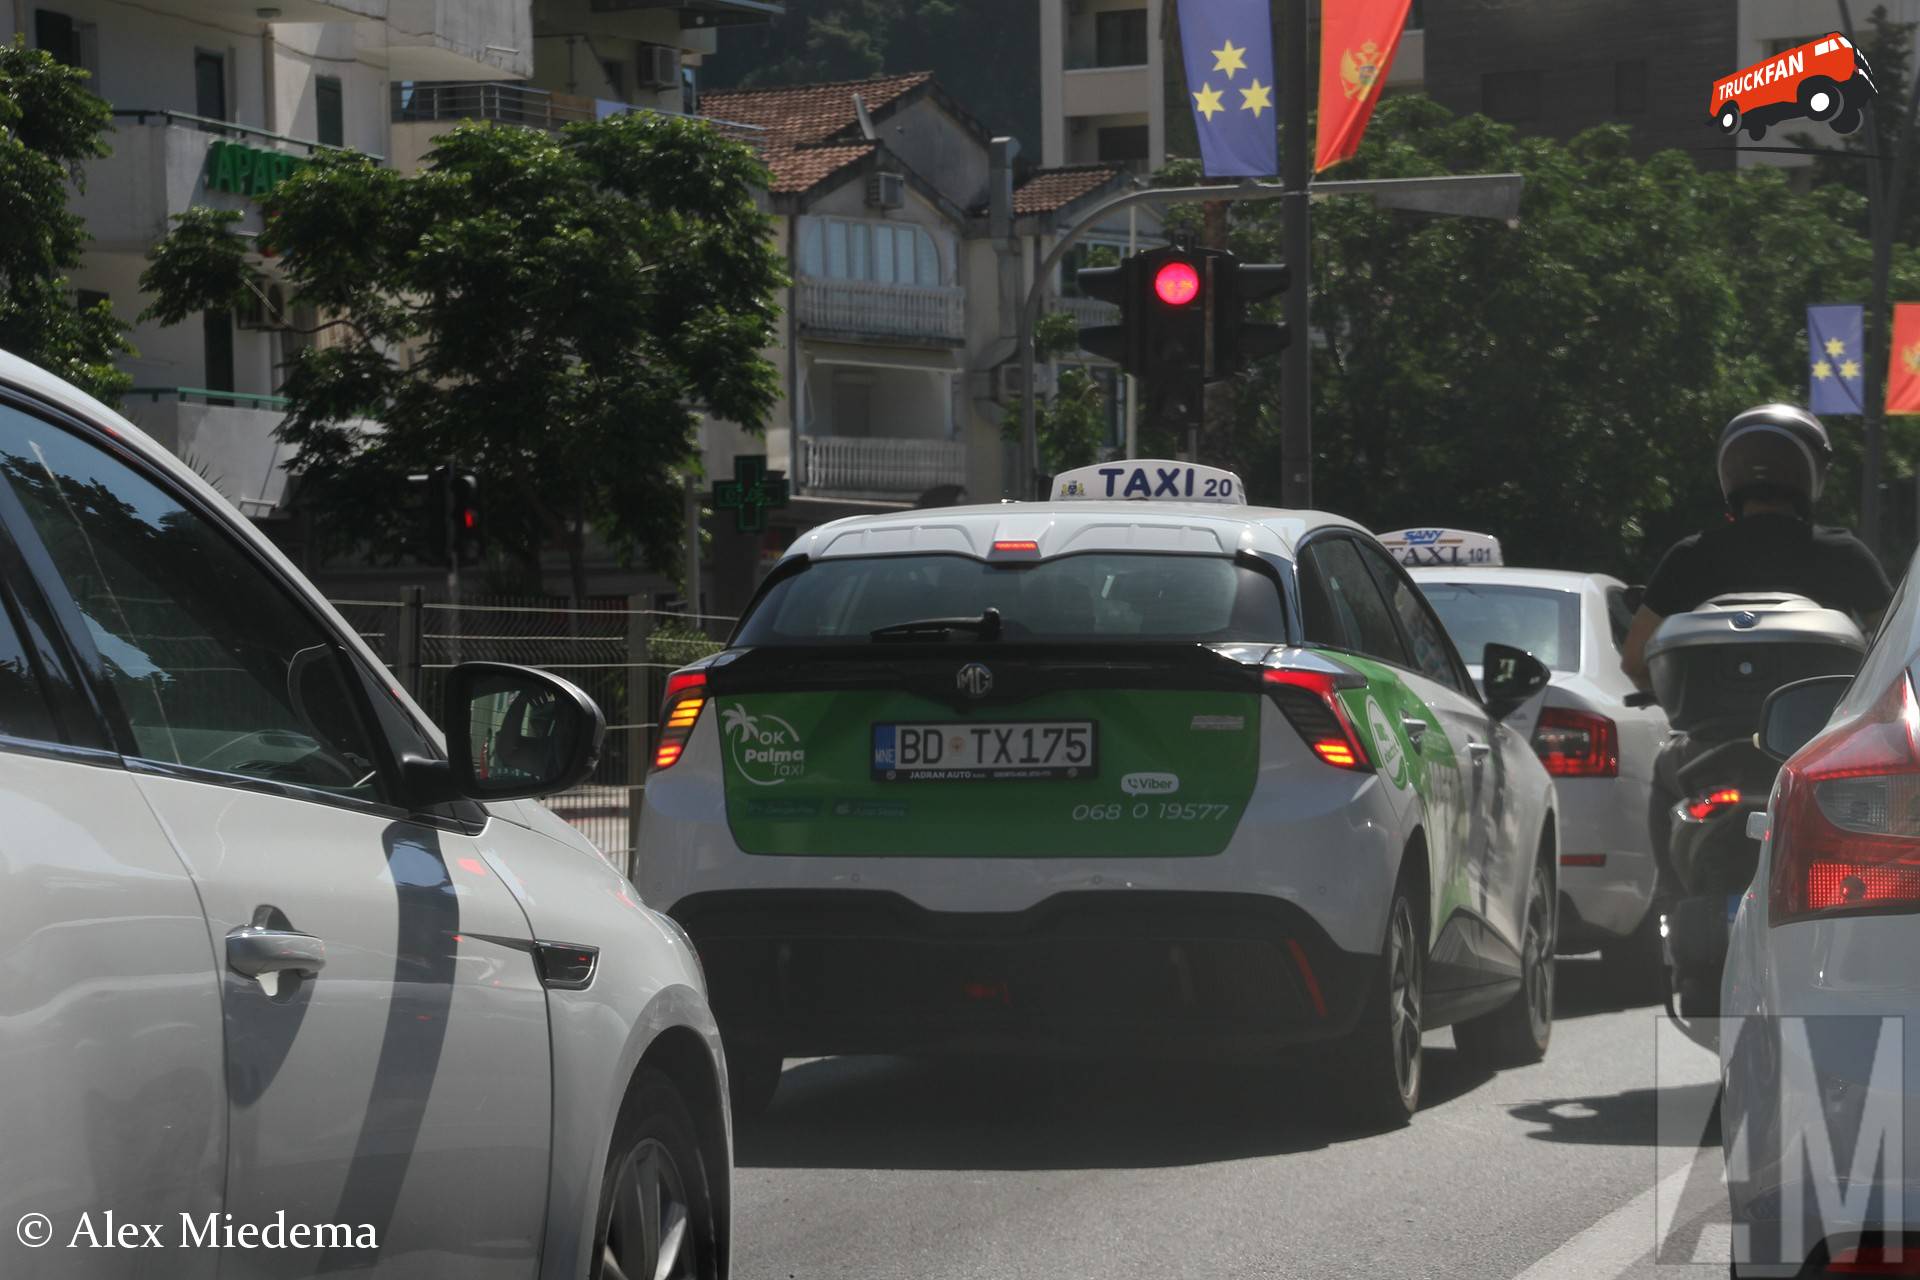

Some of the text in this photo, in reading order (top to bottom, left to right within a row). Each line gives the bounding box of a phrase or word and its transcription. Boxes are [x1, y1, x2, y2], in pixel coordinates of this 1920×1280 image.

[207, 140, 305, 197] APAR
[1098, 468, 1232, 497] TAXI 20
[1389, 546, 1491, 564] TAXI 101
[957, 664, 992, 695] MG
[759, 731, 785, 745] OK
[900, 727, 1087, 765] BD TX175
[744, 747, 805, 763] Palma
[875, 748, 896, 764] MNE
[772, 762, 805, 776] Taxi
[909, 771, 946, 779] JADRAN
[946, 770, 971, 779] AUTO
[1139, 778, 1173, 790] Viber
[1072, 803, 1122, 821] 068
[1159, 802, 1229, 821] 19577
